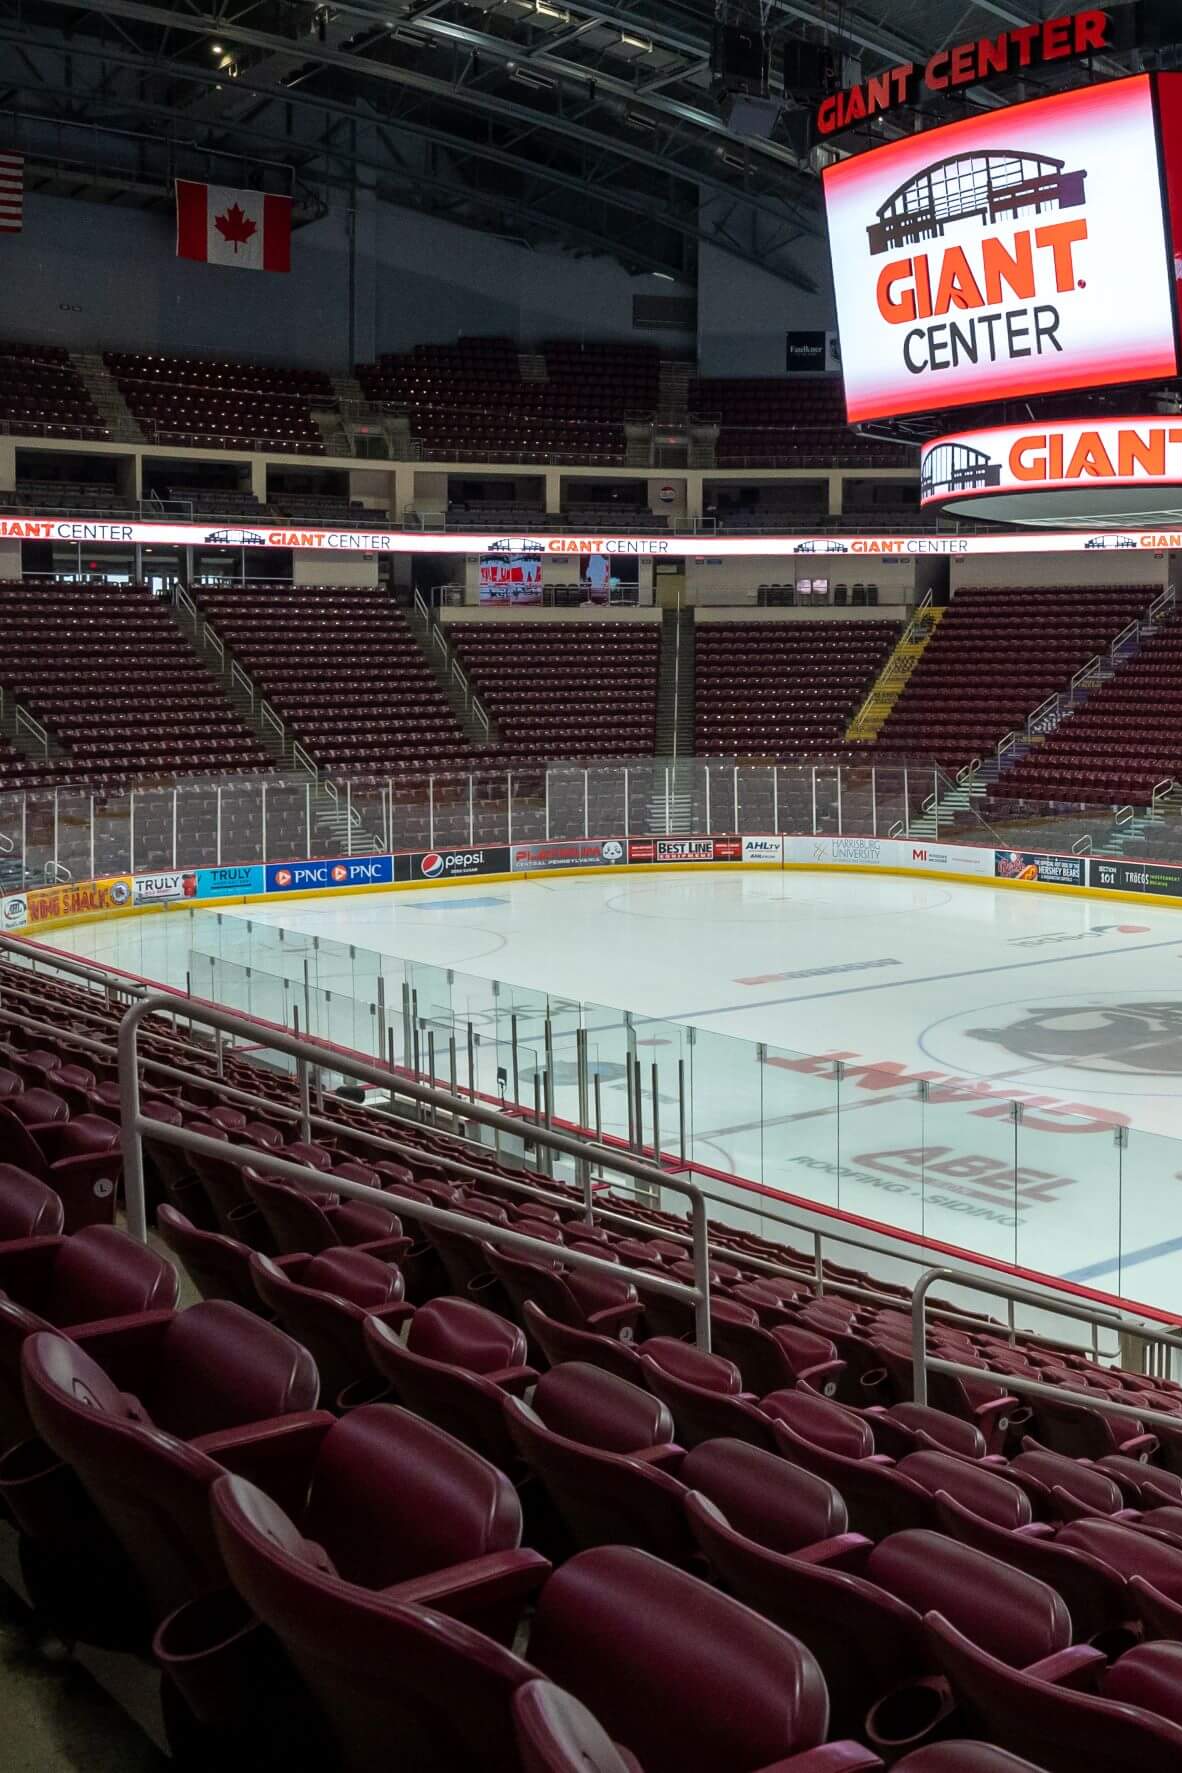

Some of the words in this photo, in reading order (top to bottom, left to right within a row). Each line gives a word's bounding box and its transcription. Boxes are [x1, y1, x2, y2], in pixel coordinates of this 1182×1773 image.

[816, 63, 913, 135] GIANT
[924, 10, 1109, 91] CENTER
[876, 218, 1088, 325] GIANT
[903, 304, 1063, 375] CENTER
[57, 524, 133, 539] CENTER
[268, 532, 325, 546] GIANT
[328, 534, 391, 549] CENTER
[548, 540, 604, 552] GIANT
[605, 540, 668, 553] CENTER
[851, 540, 904, 552] GIANT
[907, 540, 968, 553] CENTER
[658, 843, 685, 853] BEST
[688, 842, 712, 853] LINE
[445, 851, 483, 869] pepsi
[211, 868, 252, 881] TRULY
[294, 868, 327, 883] PNC
[350, 864, 382, 878] PNC
[1040, 867, 1062, 876] HERSHEY
[1062, 868, 1080, 877] BEARS
[1100, 873, 1115, 884] 101
[136, 876, 180, 891] TRULY
[789, 1155, 910, 1193] ROOFING
[920, 1195, 1028, 1227] SIDING
